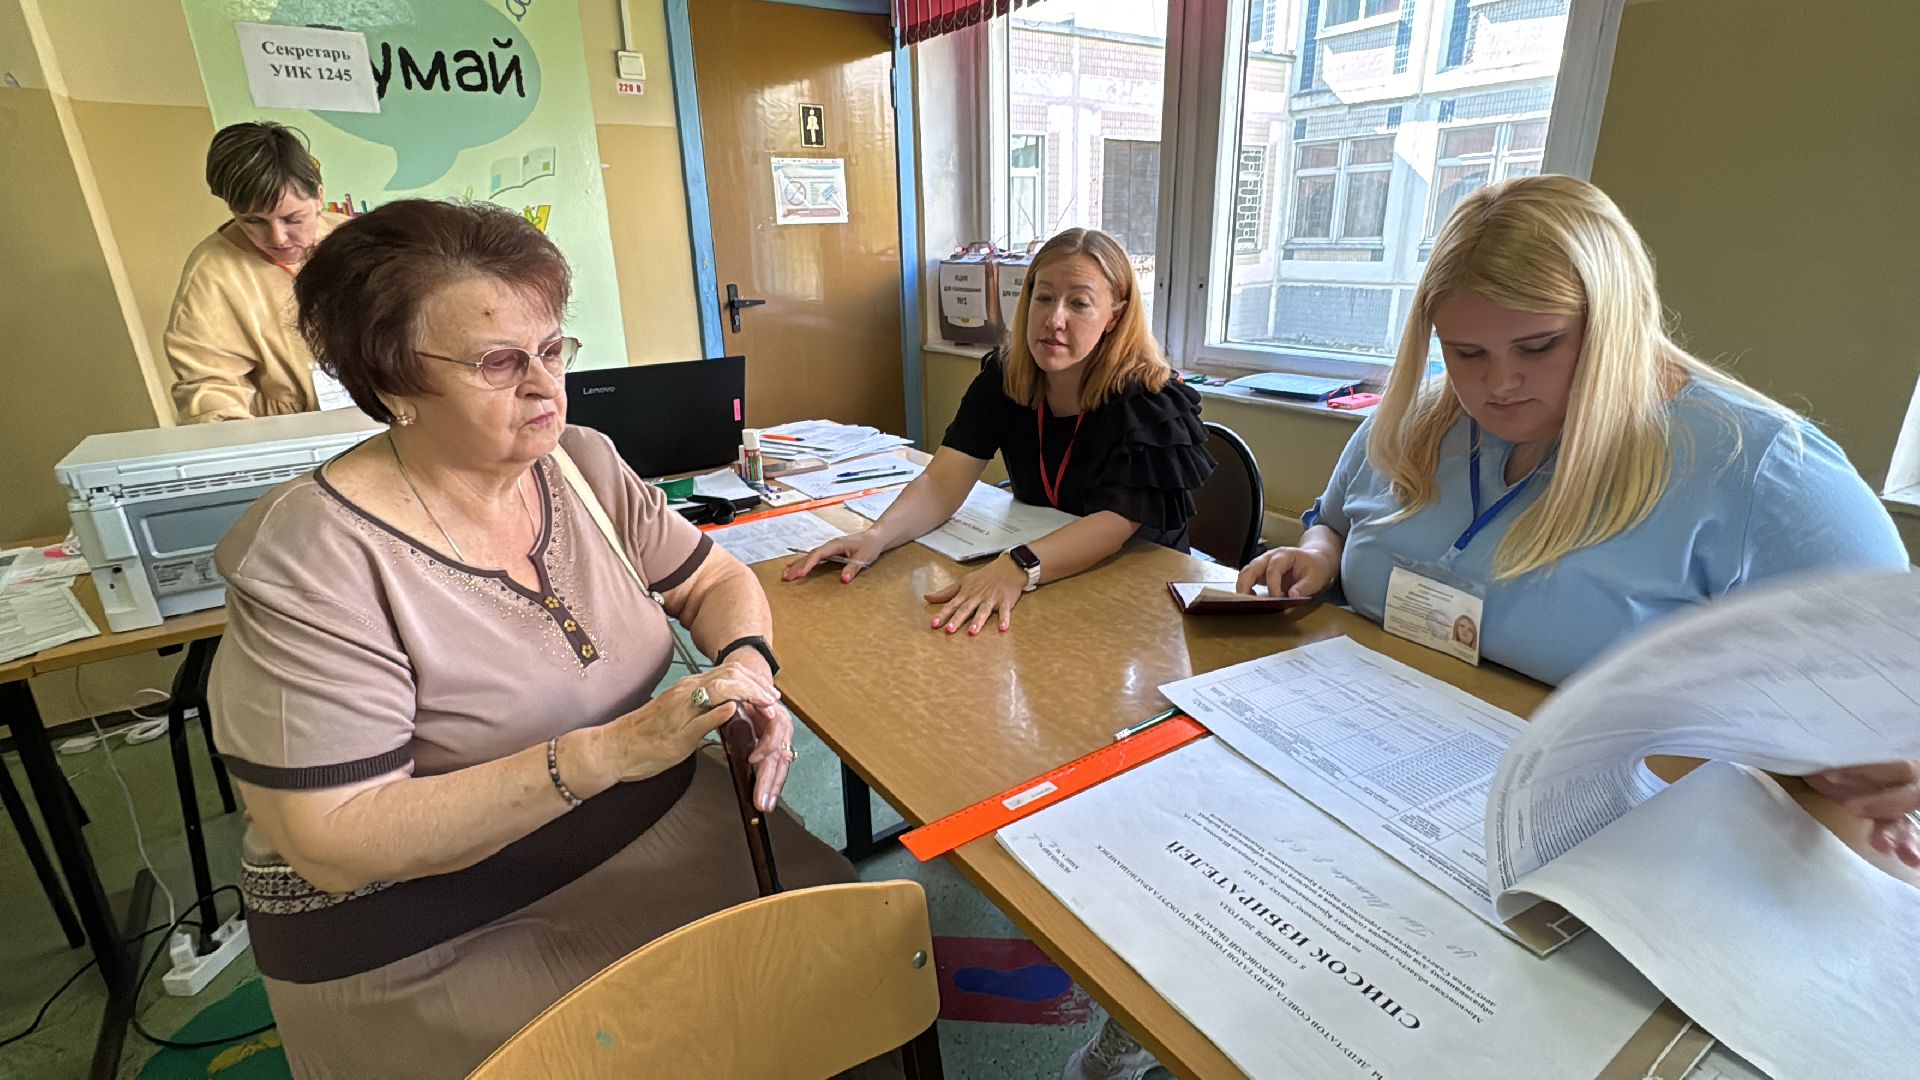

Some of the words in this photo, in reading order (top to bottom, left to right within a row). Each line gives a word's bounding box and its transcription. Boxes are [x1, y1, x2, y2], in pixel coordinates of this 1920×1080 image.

[261, 41, 351, 62] Секретарь
[269, 63, 313, 79] УИК
[318, 67, 353, 82] 1245
[371, 37, 526, 101] умай
[618, 83, 634, 93] 220
[583, 387, 616, 395] Lenovo
[1166, 841, 1309, 947] ИЗБИРАТЕЛЕЙ
[1220, 901, 1240, 919] ГОДА
[1194, 912, 1230, 942] ОБЛАСТИ
[1255, 930, 1298, 964] СЕНТЯБРЯ
[1226, 952, 1278, 991] ДЕПУТАТОВ
[1228, 941, 1287, 988] МОСКОВСКОЙ
[1309, 947, 1420, 1029] СПИСОК
[1429, 983, 1483, 1023] Московская
[1277, 991, 1311, 1021] СОВЕТА
[1310, 1021, 1371, 1068] ДЕПУТАТОВ
